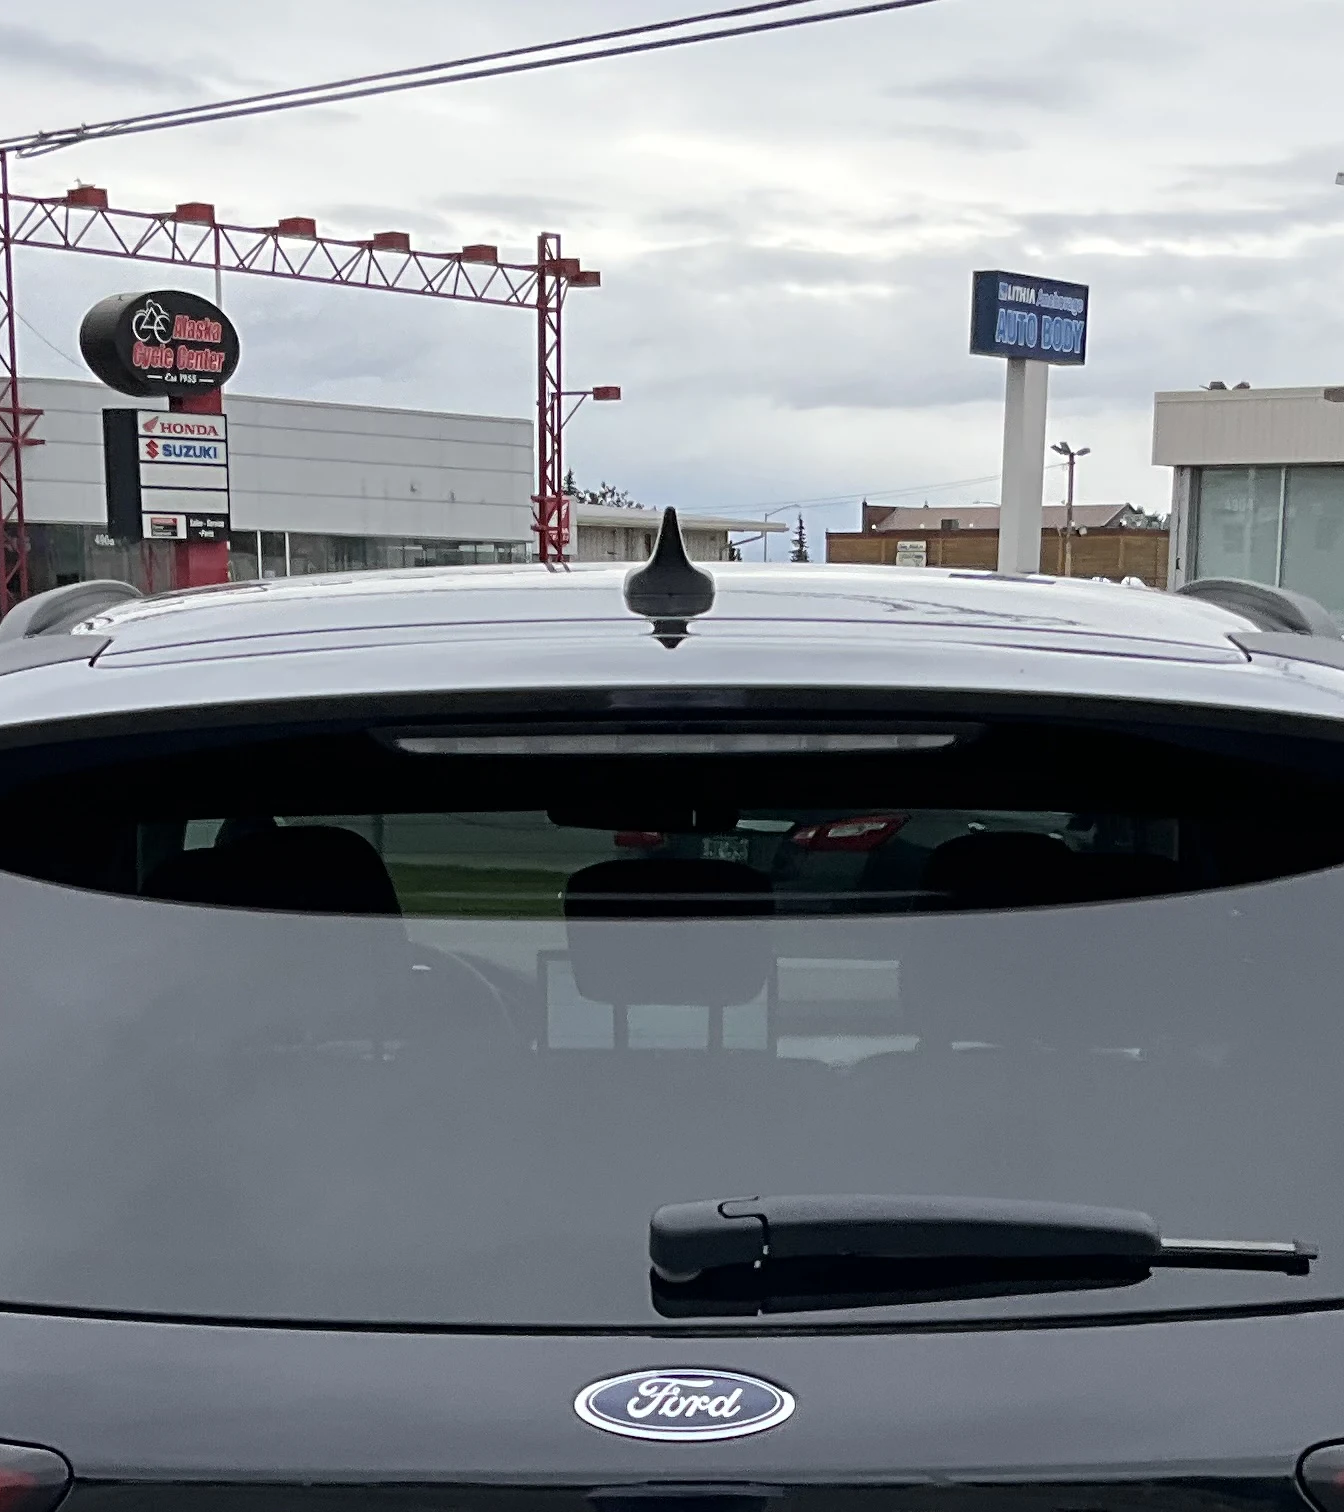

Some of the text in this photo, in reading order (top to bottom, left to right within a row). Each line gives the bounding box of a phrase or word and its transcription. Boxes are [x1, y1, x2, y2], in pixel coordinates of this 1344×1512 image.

[1007, 284, 1036, 305] LITHIA
[172, 314, 222, 343] Alaska
[995, 308, 1084, 354] AUTO BODY
[133, 341, 225, 373] Cycle Center
[159, 421, 219, 436] HONDA
[162, 443, 218, 459] SUZUKI
[626, 1377, 744, 1419] Ford
